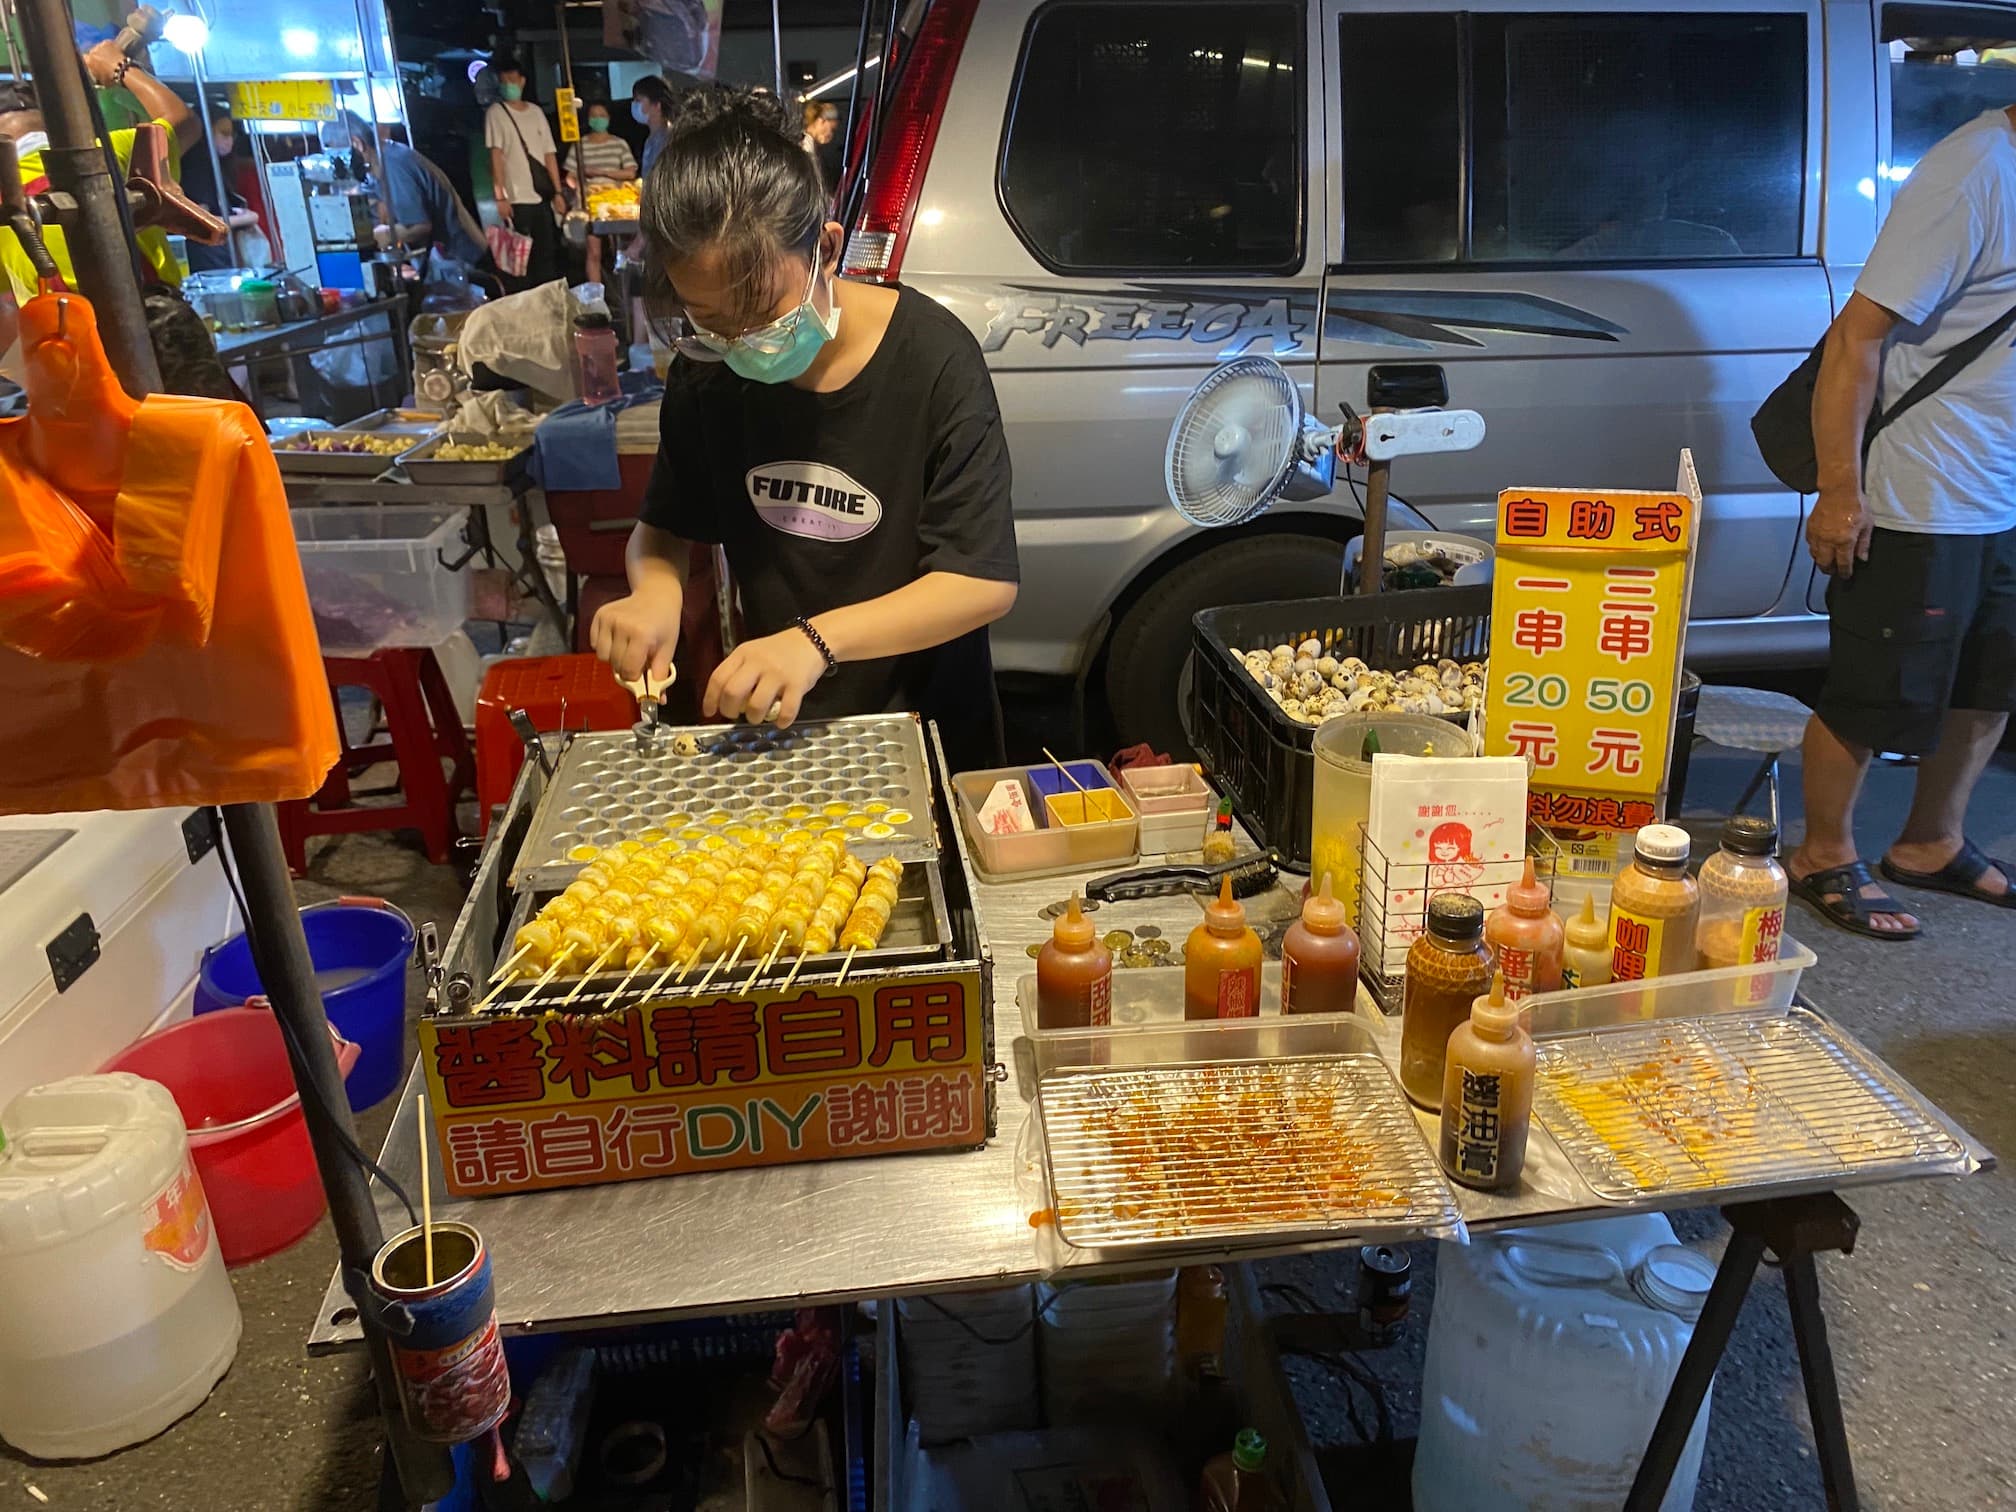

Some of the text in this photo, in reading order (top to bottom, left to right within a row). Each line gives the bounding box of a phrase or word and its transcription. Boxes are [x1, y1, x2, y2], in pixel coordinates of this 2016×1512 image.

[753, 475, 866, 516] FUTURE
[1505, 498, 1682, 542] 自助式
[1611, 916, 1650, 983] 咖哩
[434, 981, 967, 1108] 醬料請自用
[449, 1072, 974, 1187] 請自行DIY謝謝
[1460, 1069, 1500, 1176] 醬油膏
